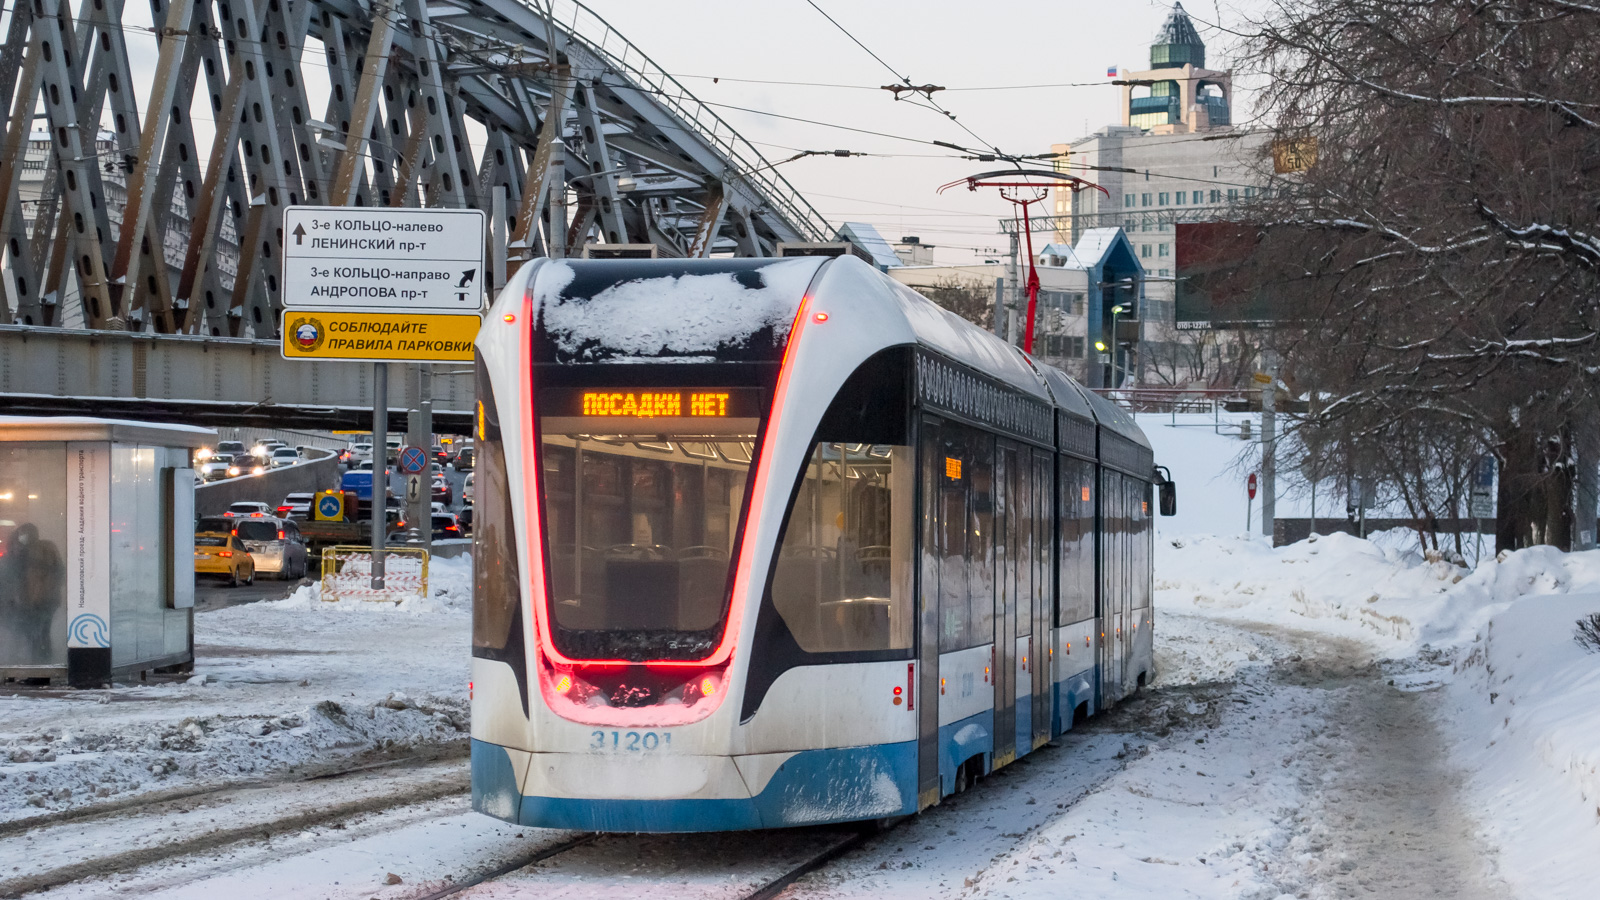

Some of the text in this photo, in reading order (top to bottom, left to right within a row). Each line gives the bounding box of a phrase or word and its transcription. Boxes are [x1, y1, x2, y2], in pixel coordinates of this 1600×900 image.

[311, 219, 444, 233] 3-е КОЛЬЦО-налево
[311, 237, 426, 253] ЛЕНИНСКИЙ пр-т
[310, 267, 450, 282] 3-е КОЛЬЦО-направо
[310, 286, 428, 301] АНДРОПОВА пр-т
[329, 321, 428, 335] СОБЛЮДАЙТЕ
[328, 339, 393, 351] ПРАВИЛА
[583, 392, 729, 418] ПОСАДКИ НЕТ
[78, 558, 86, 608] Новоданиловский
[590, 730, 671, 751] 31201
